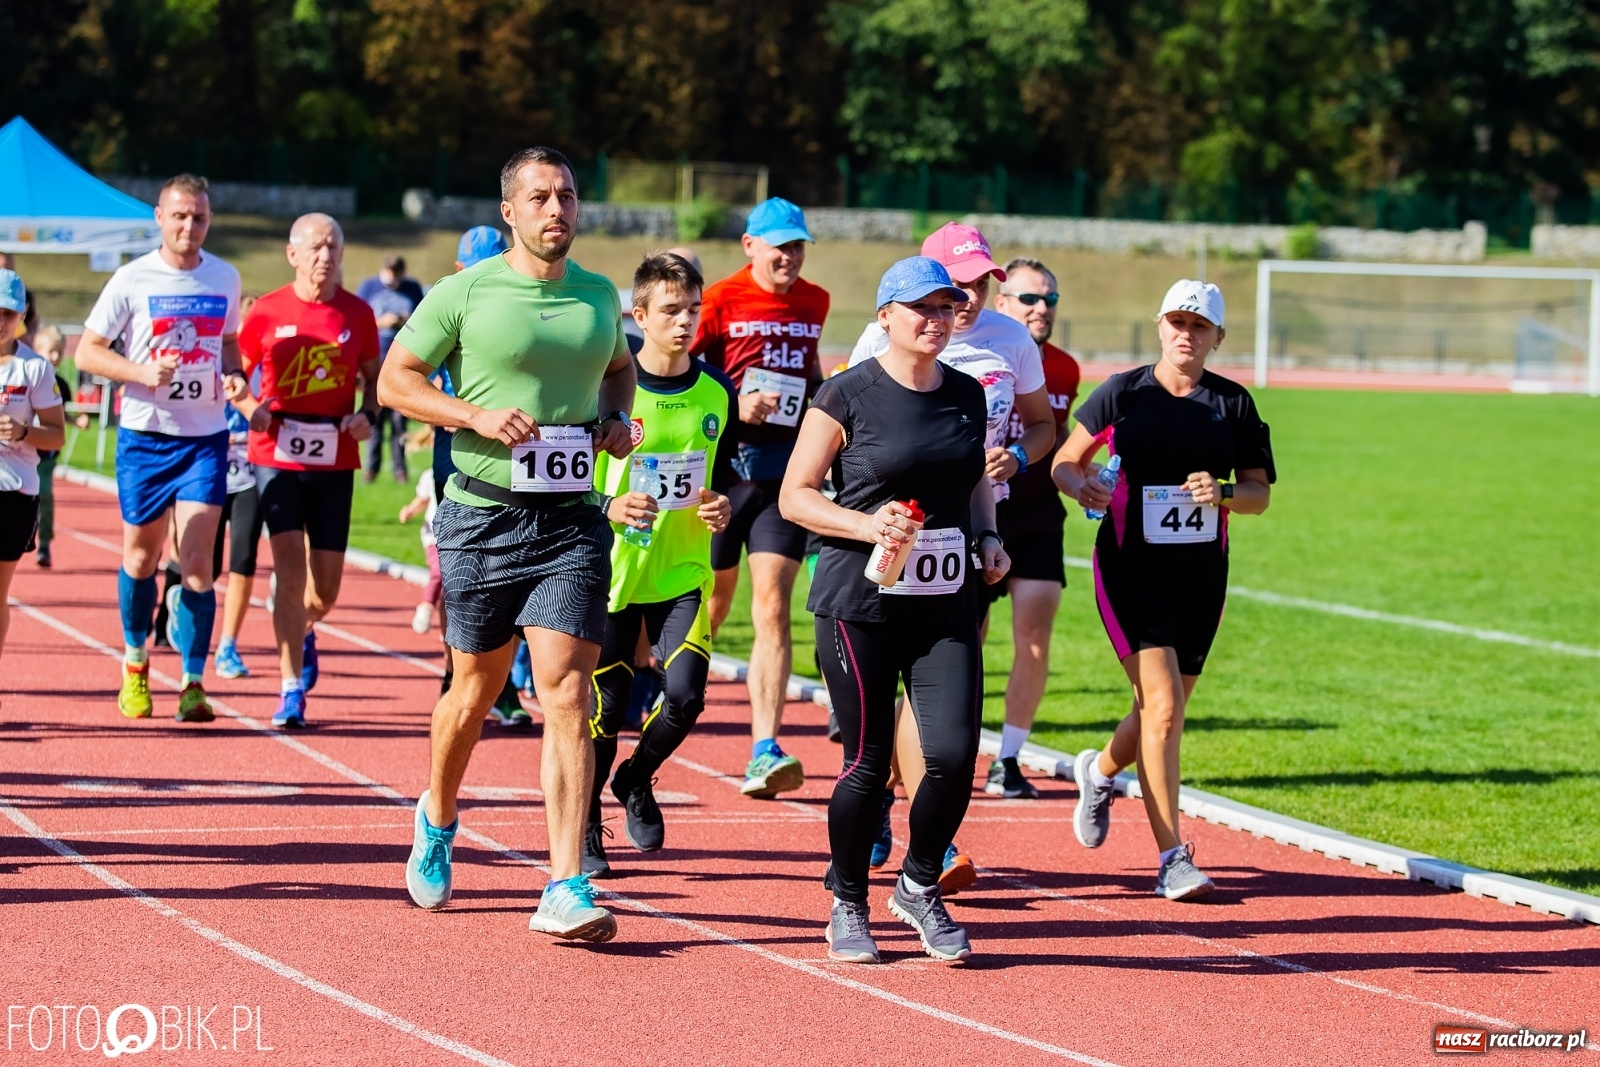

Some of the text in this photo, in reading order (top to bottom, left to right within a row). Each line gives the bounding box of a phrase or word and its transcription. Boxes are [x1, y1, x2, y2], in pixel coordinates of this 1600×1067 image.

[952, 240, 991, 256] adida
[762, 342, 805, 369] isla
[168, 380, 202, 400] 29
[289, 437, 325, 457] 92
[519, 450, 590, 480] 166
[1160, 506, 1204, 532] 44
[896, 552, 961, 584] 00
